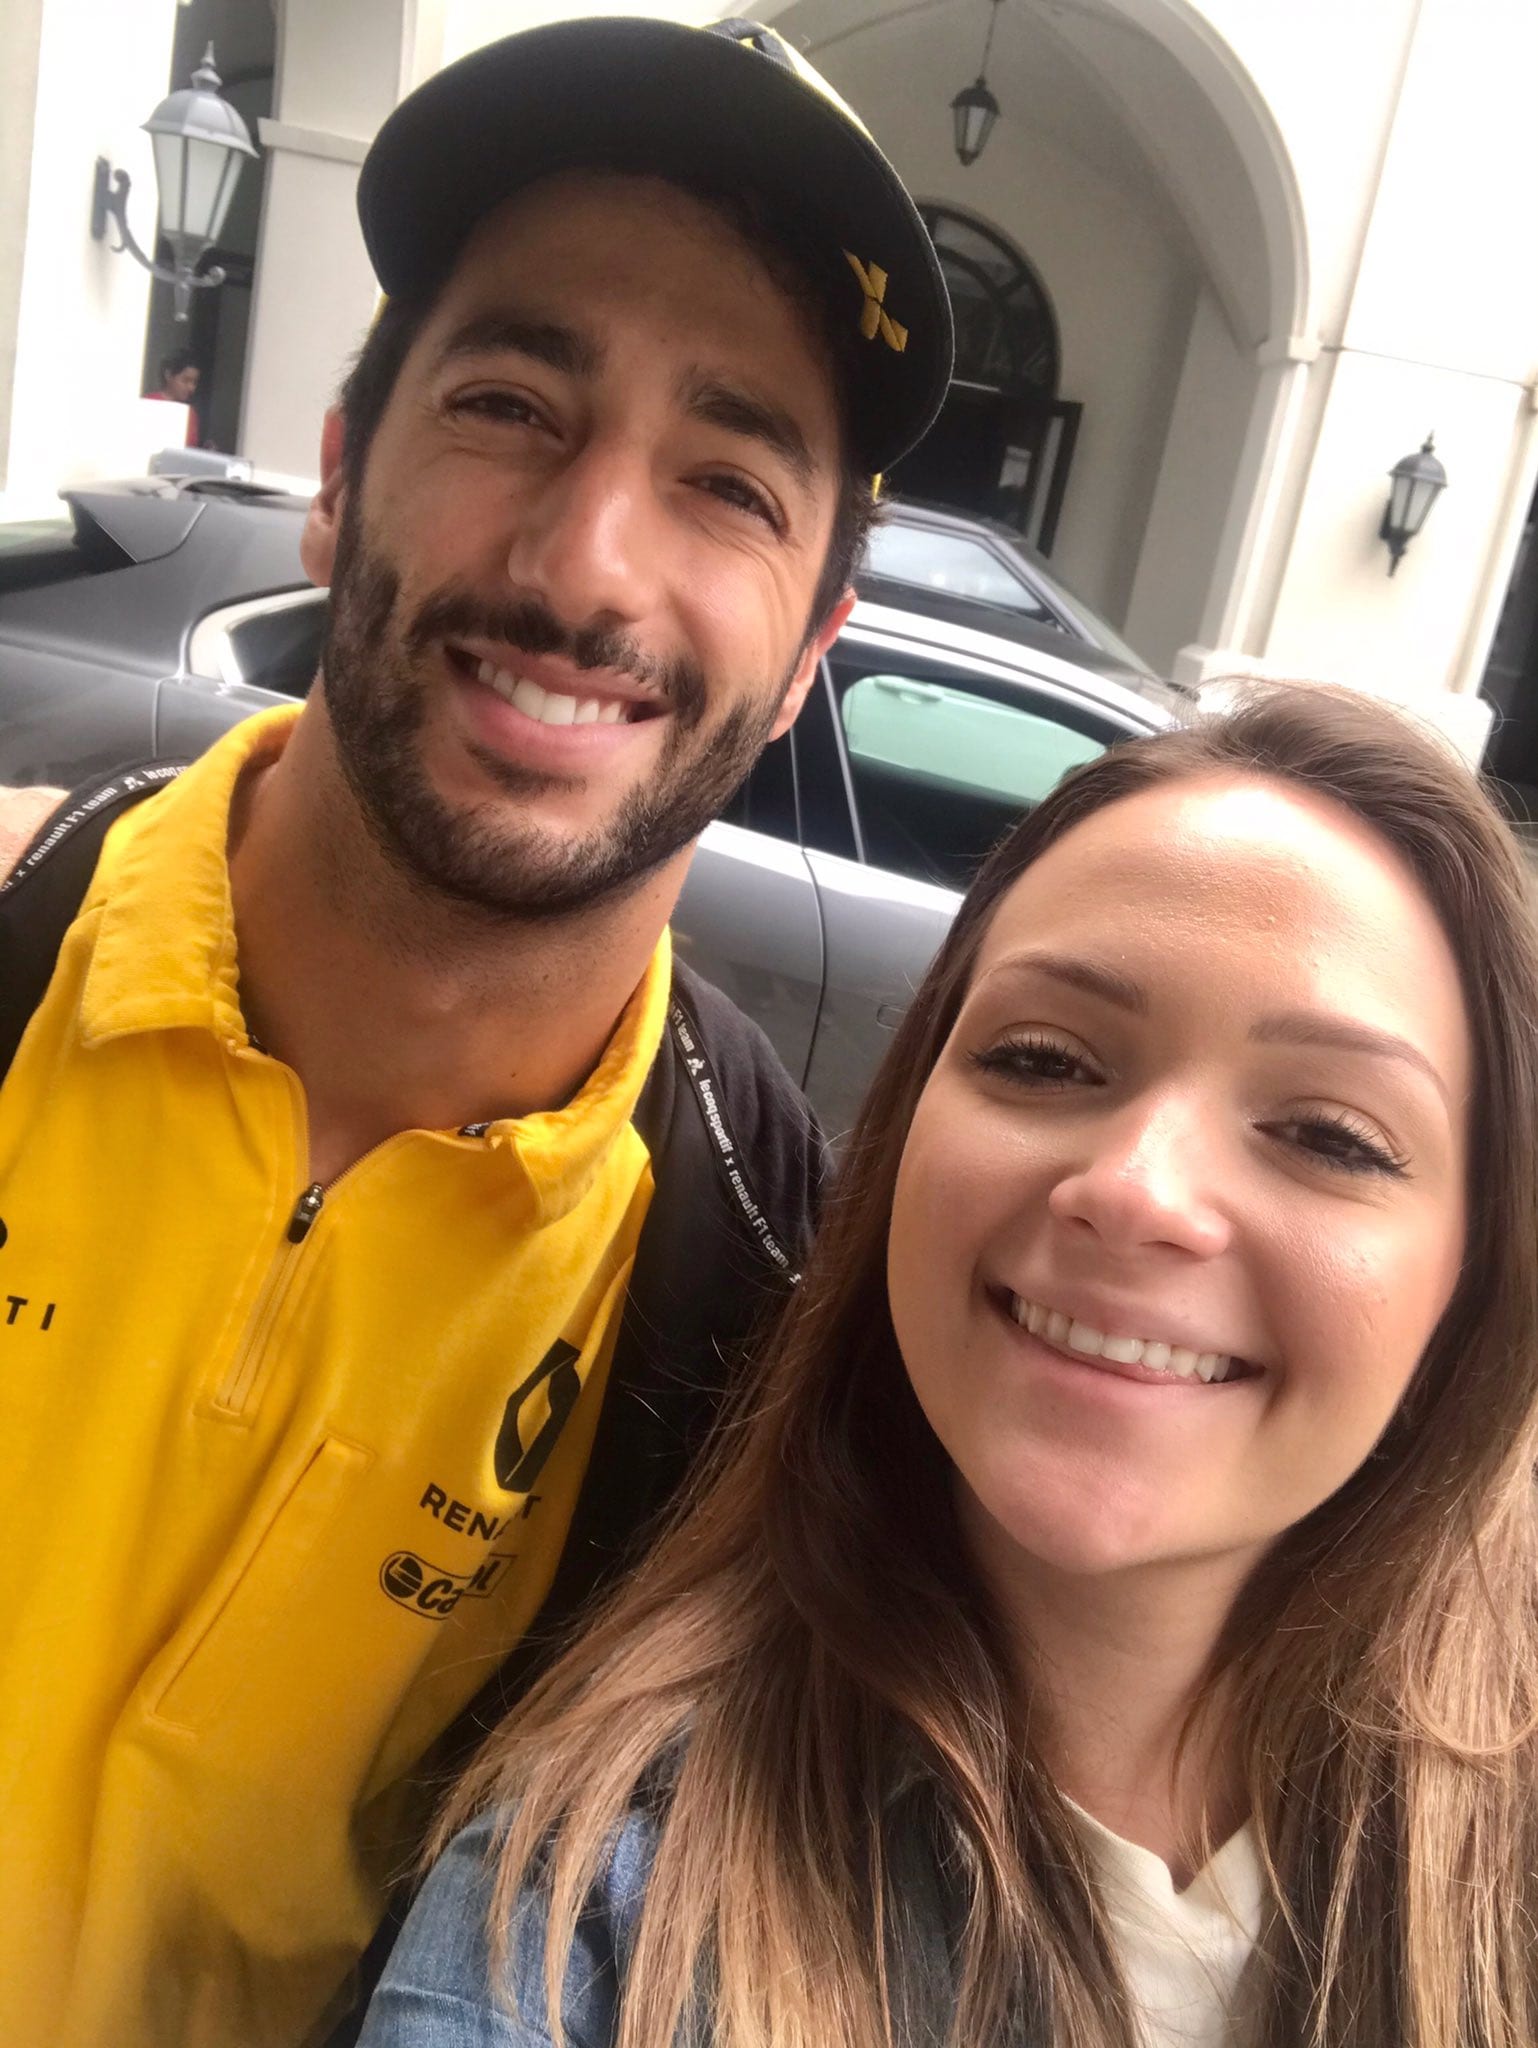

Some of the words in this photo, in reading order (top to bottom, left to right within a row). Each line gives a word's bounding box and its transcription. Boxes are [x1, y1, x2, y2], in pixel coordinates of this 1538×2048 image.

[26, 822, 73, 866] renault
[65, 810, 86, 823] F1
[81, 787, 118, 810] team
[677, 1022, 695, 1053] team
[729, 1169, 759, 1220] renault
[752, 1217, 769, 1236] F1
[762, 1234, 790, 1268] team
